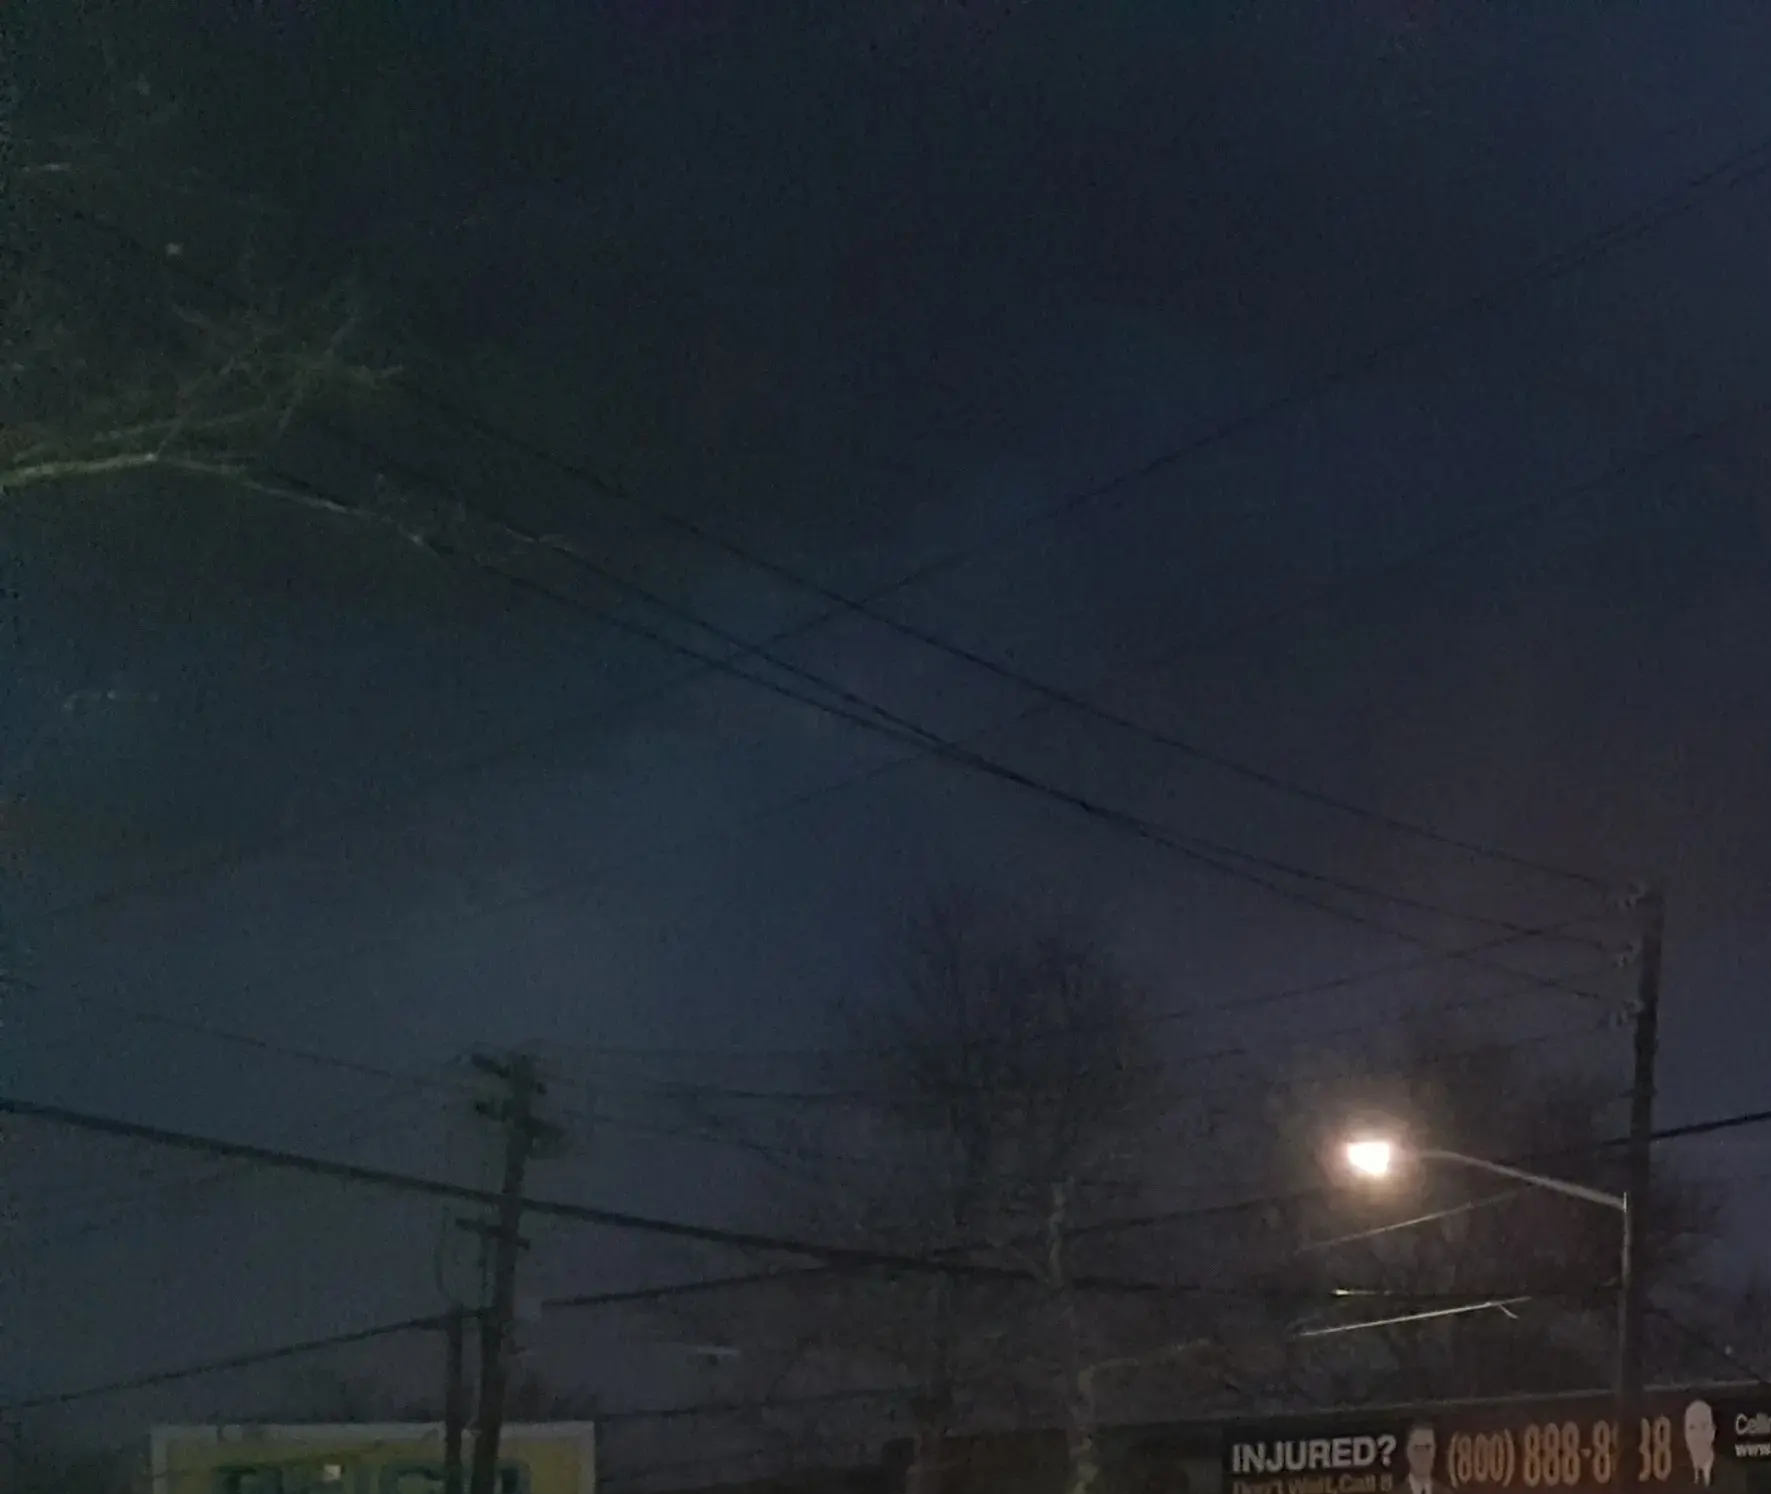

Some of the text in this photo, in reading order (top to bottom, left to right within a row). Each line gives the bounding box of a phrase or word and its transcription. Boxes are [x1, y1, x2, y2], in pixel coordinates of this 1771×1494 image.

[1232, 1434, 1397, 1473] INJURED?
[1448, 1413, 1672, 1489] (800) 888-88
